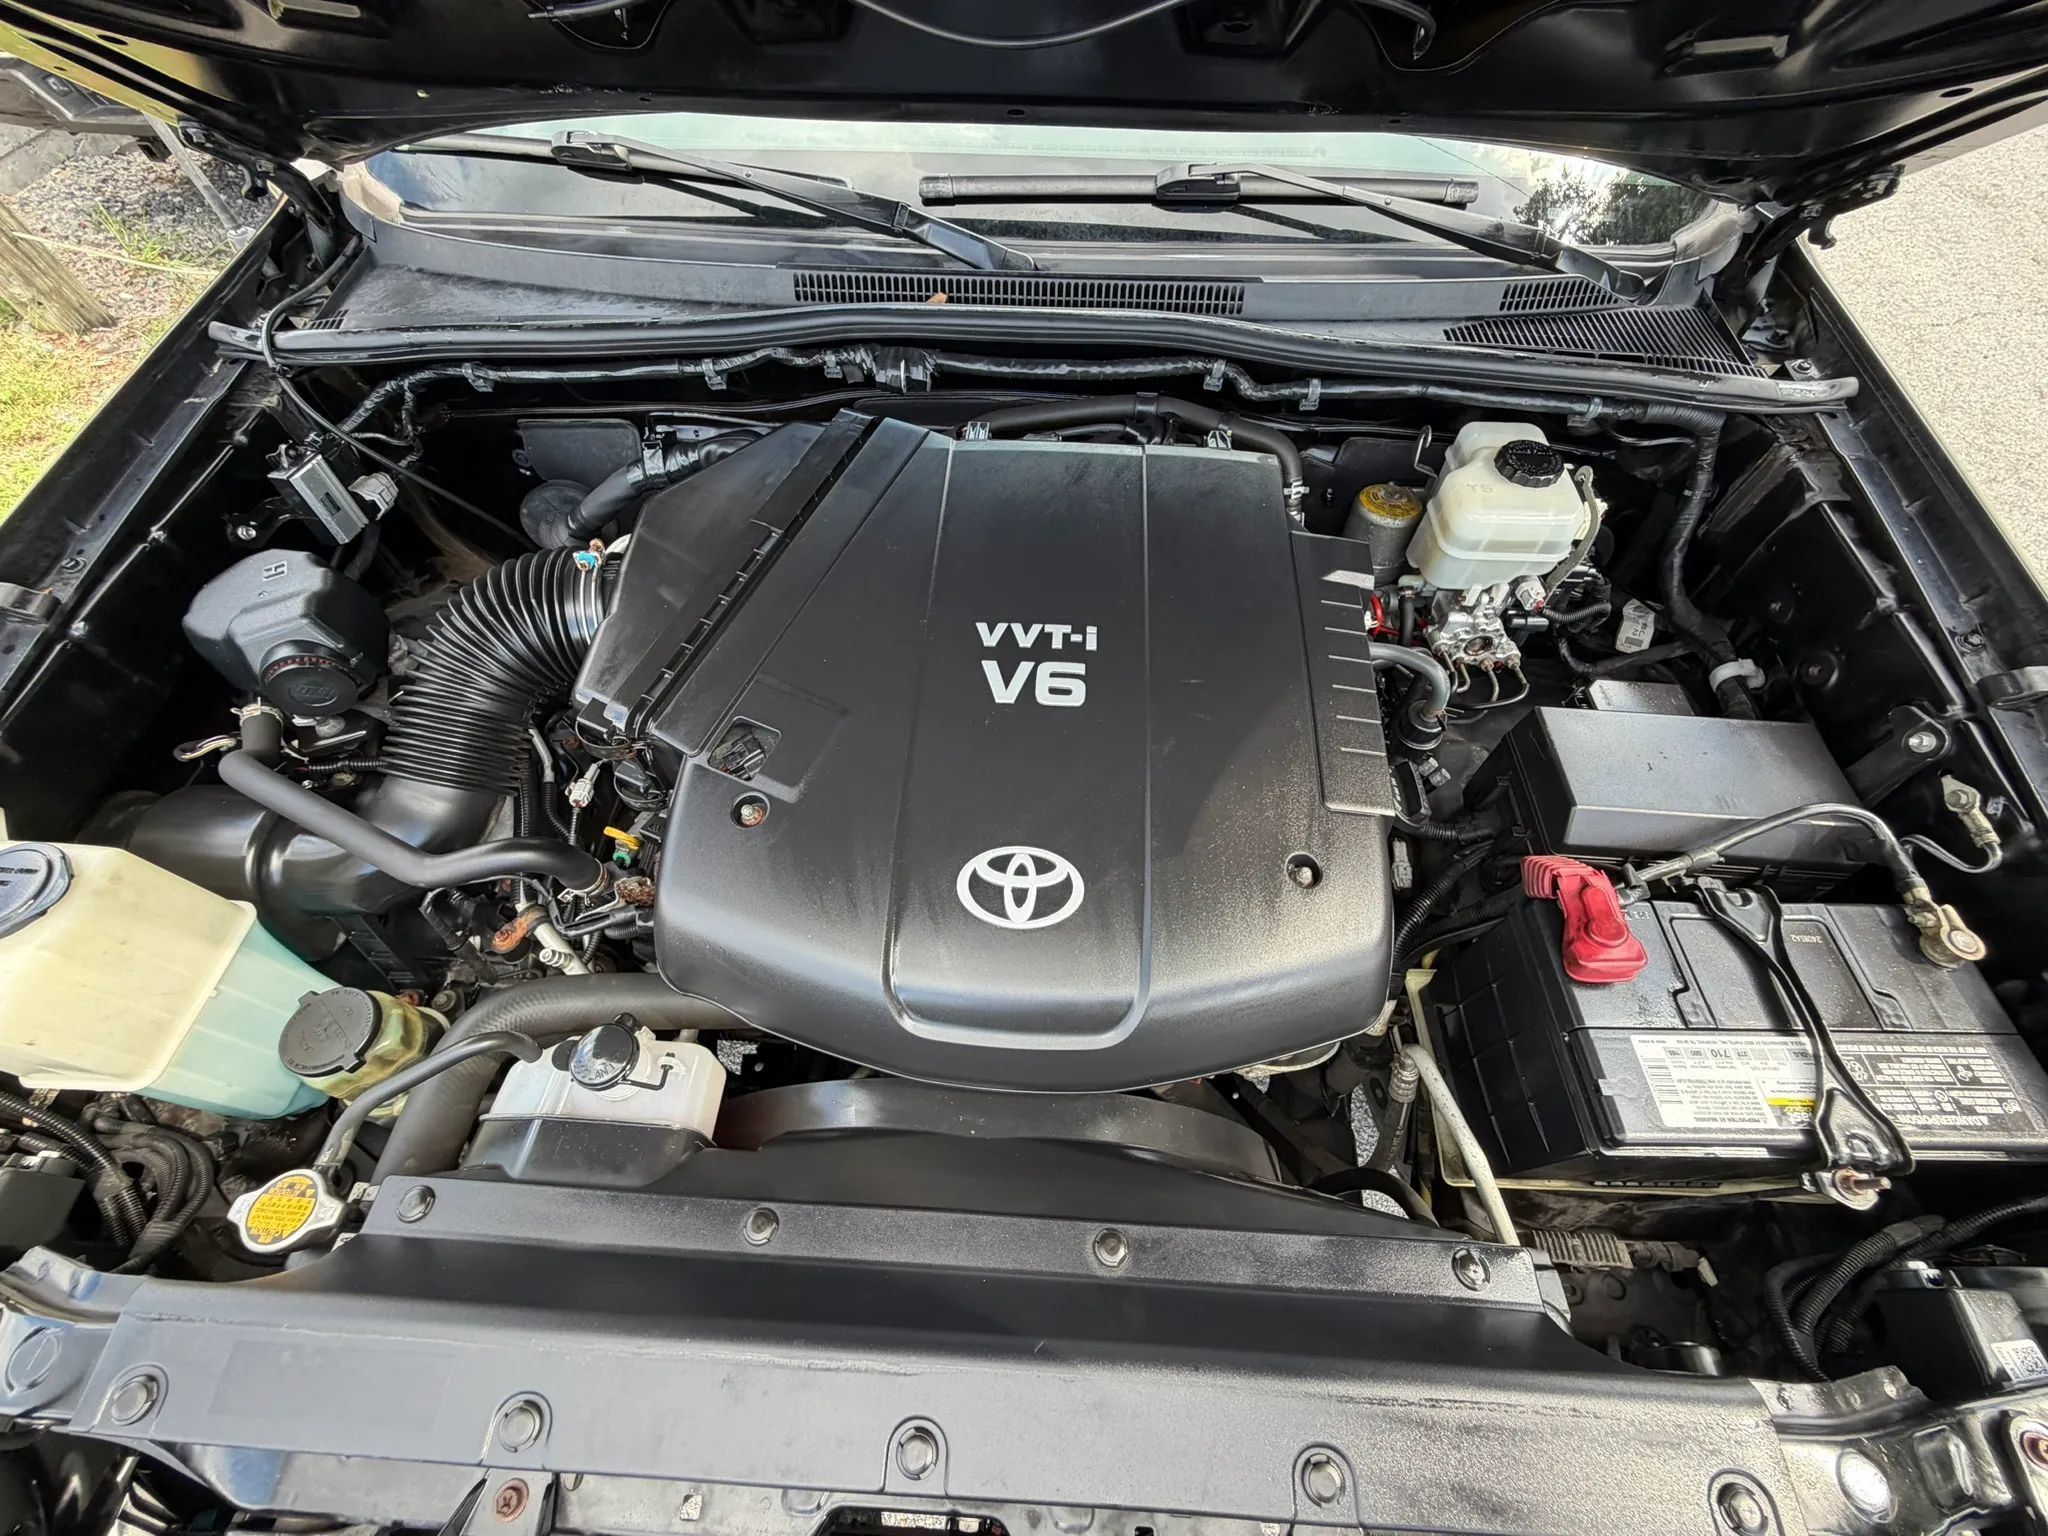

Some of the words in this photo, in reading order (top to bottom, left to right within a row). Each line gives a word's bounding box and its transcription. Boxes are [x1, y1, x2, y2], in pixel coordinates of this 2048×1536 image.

[975, 622, 1097, 651] VVT-i
[981, 660, 1086, 707] V6
[1711, 1049, 1730, 1058] 710
